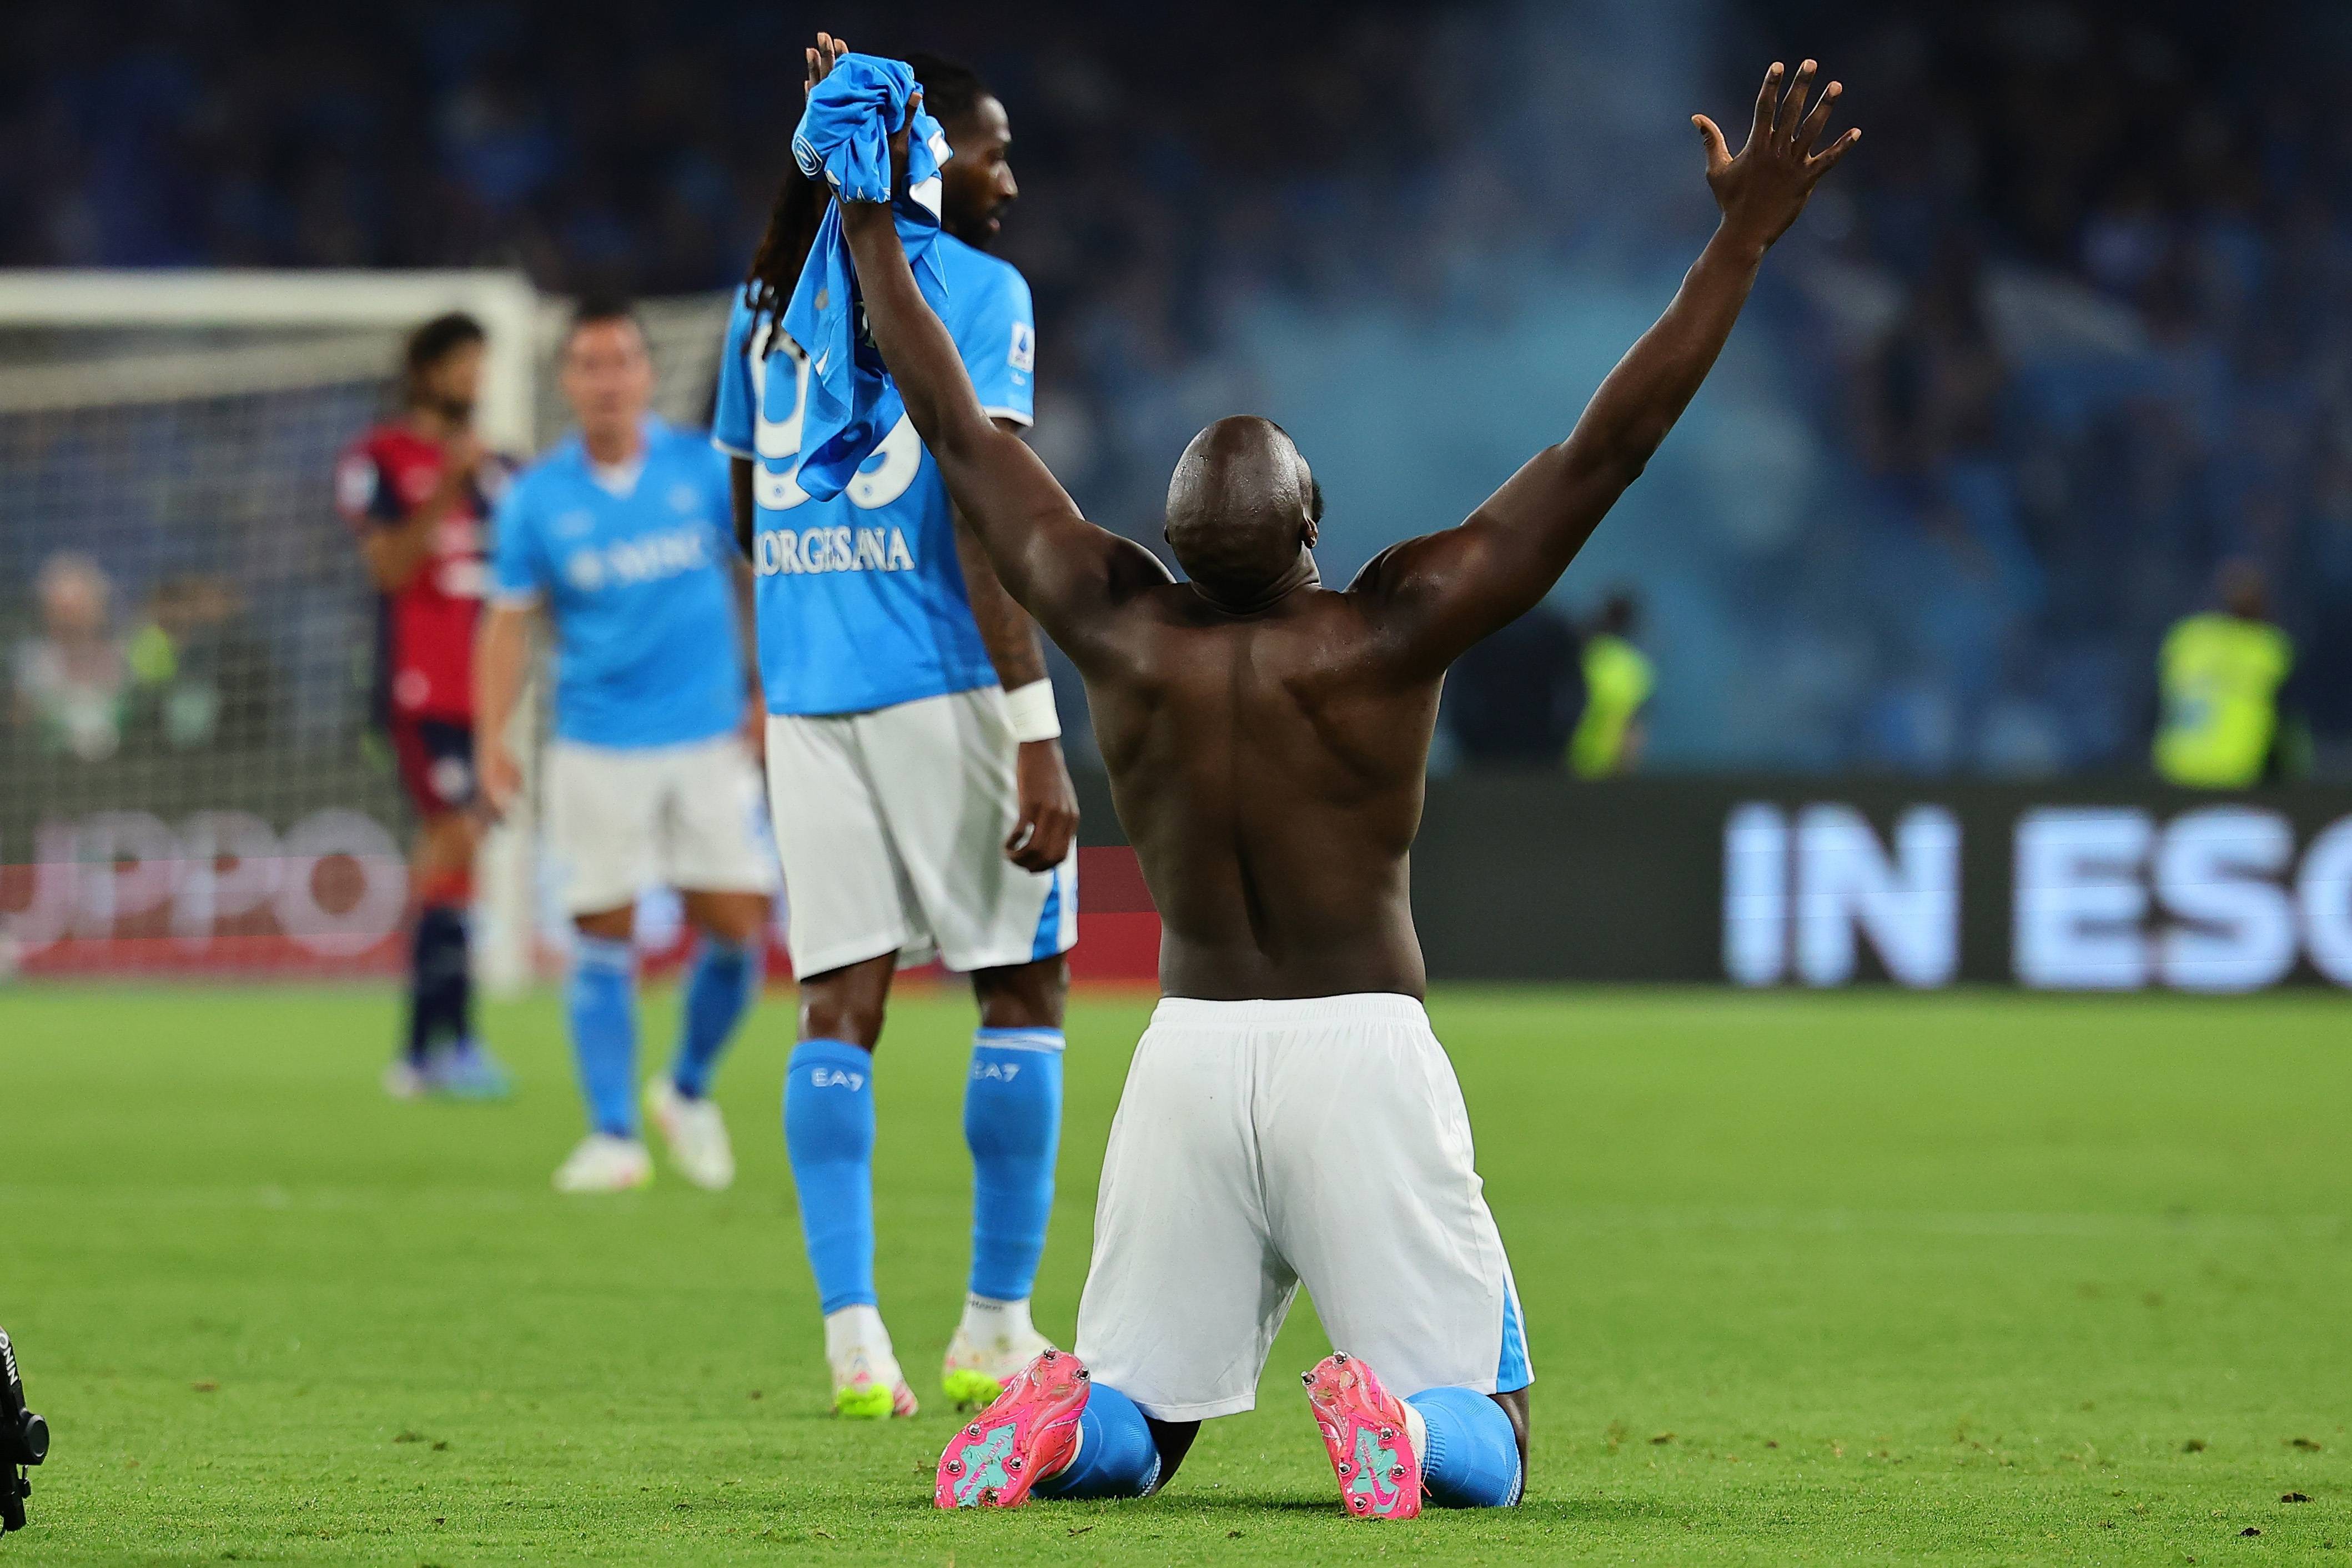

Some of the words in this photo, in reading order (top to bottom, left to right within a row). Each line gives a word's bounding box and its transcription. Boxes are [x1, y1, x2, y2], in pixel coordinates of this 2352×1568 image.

[1722, 801, 1960, 986] IN
[811, 1068, 864, 1092] EA7
[972, 1061, 1021, 1083] EA7
